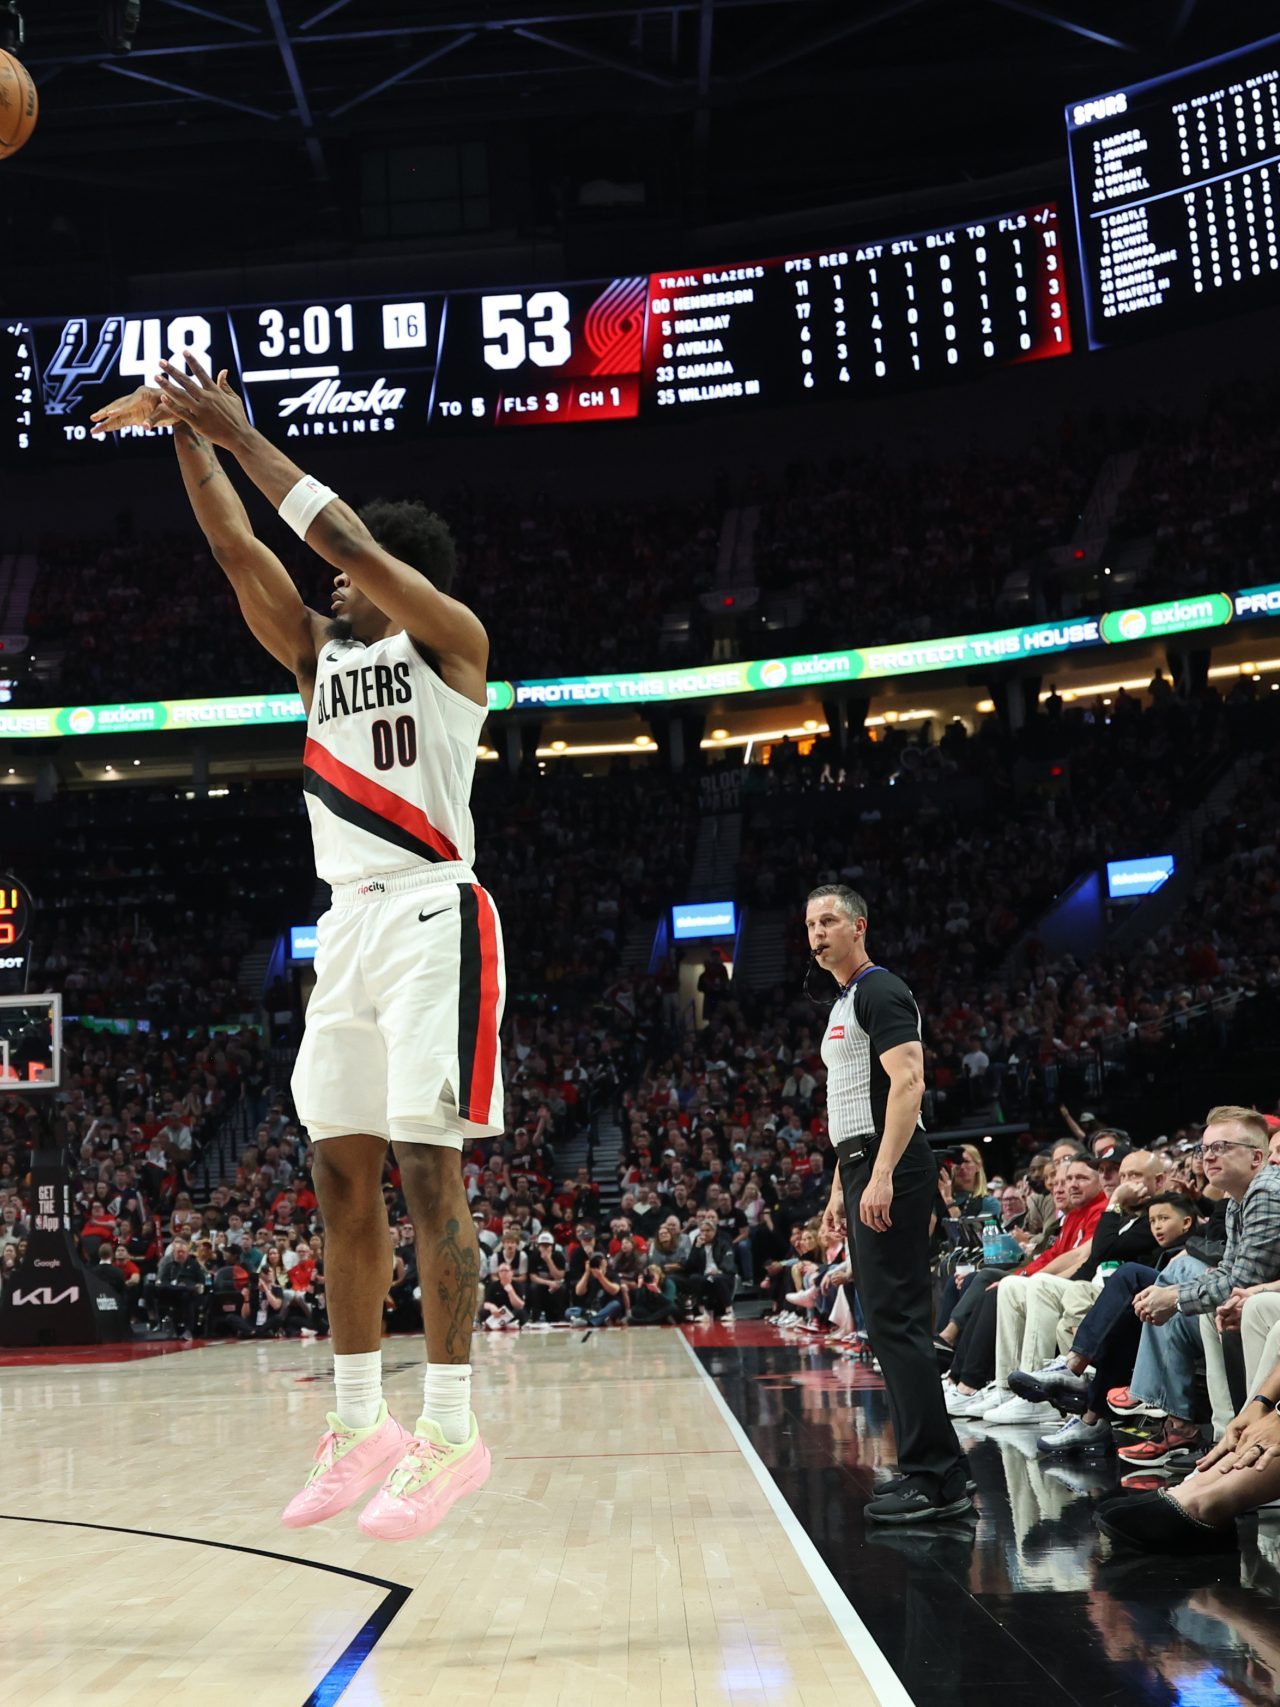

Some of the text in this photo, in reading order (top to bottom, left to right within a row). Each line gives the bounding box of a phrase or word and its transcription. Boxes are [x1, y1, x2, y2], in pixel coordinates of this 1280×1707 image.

[1073, 93, 1128, 126] SPURS
[784, 215, 1027, 273] PTS REB AST STL BLK TO FLS
[658, 266, 765, 289] TRAIL BLAZERS
[651, 288, 754, 314] 00 HENDERSON
[259, 304, 354, 357] 3:01
[393, 314, 419, 338] 16
[481, 291, 572, 370] 53
[674, 314, 730, 334] HOLIDAY
[119, 316, 212, 391] 48
[656, 360, 734, 383] 33 CAMARA
[278, 377, 407, 417] Alaska
[503, 392, 559, 412] FLS 3
[578, 387, 620, 408] CH 1
[657, 388, 676, 405] 35
[678, 382, 743, 403] WILLIAMS
[438, 397, 485, 417] TO 5
[63, 425, 87, 440] TO
[287, 417, 396, 437] AIRLINES
[1150, 600, 1213, 626] axiom
[870, 622, 1099, 671] PROTECT THIS HOUSE
[791, 652, 850, 676] axiom
[318, 662, 413, 725] BLAZERS
[516, 671, 739, 704] PROTECT THIS HOUSE
[98, 705, 156, 722] axiom
[173, 701, 266, 724] PROTECT
[371, 715, 418, 771] 00
[38, 1185, 55, 1200] GET
[39, 1200, 56, 1214] THE
[43, 1216, 59, 1232] App
[33, 1259, 60, 1269] Google
